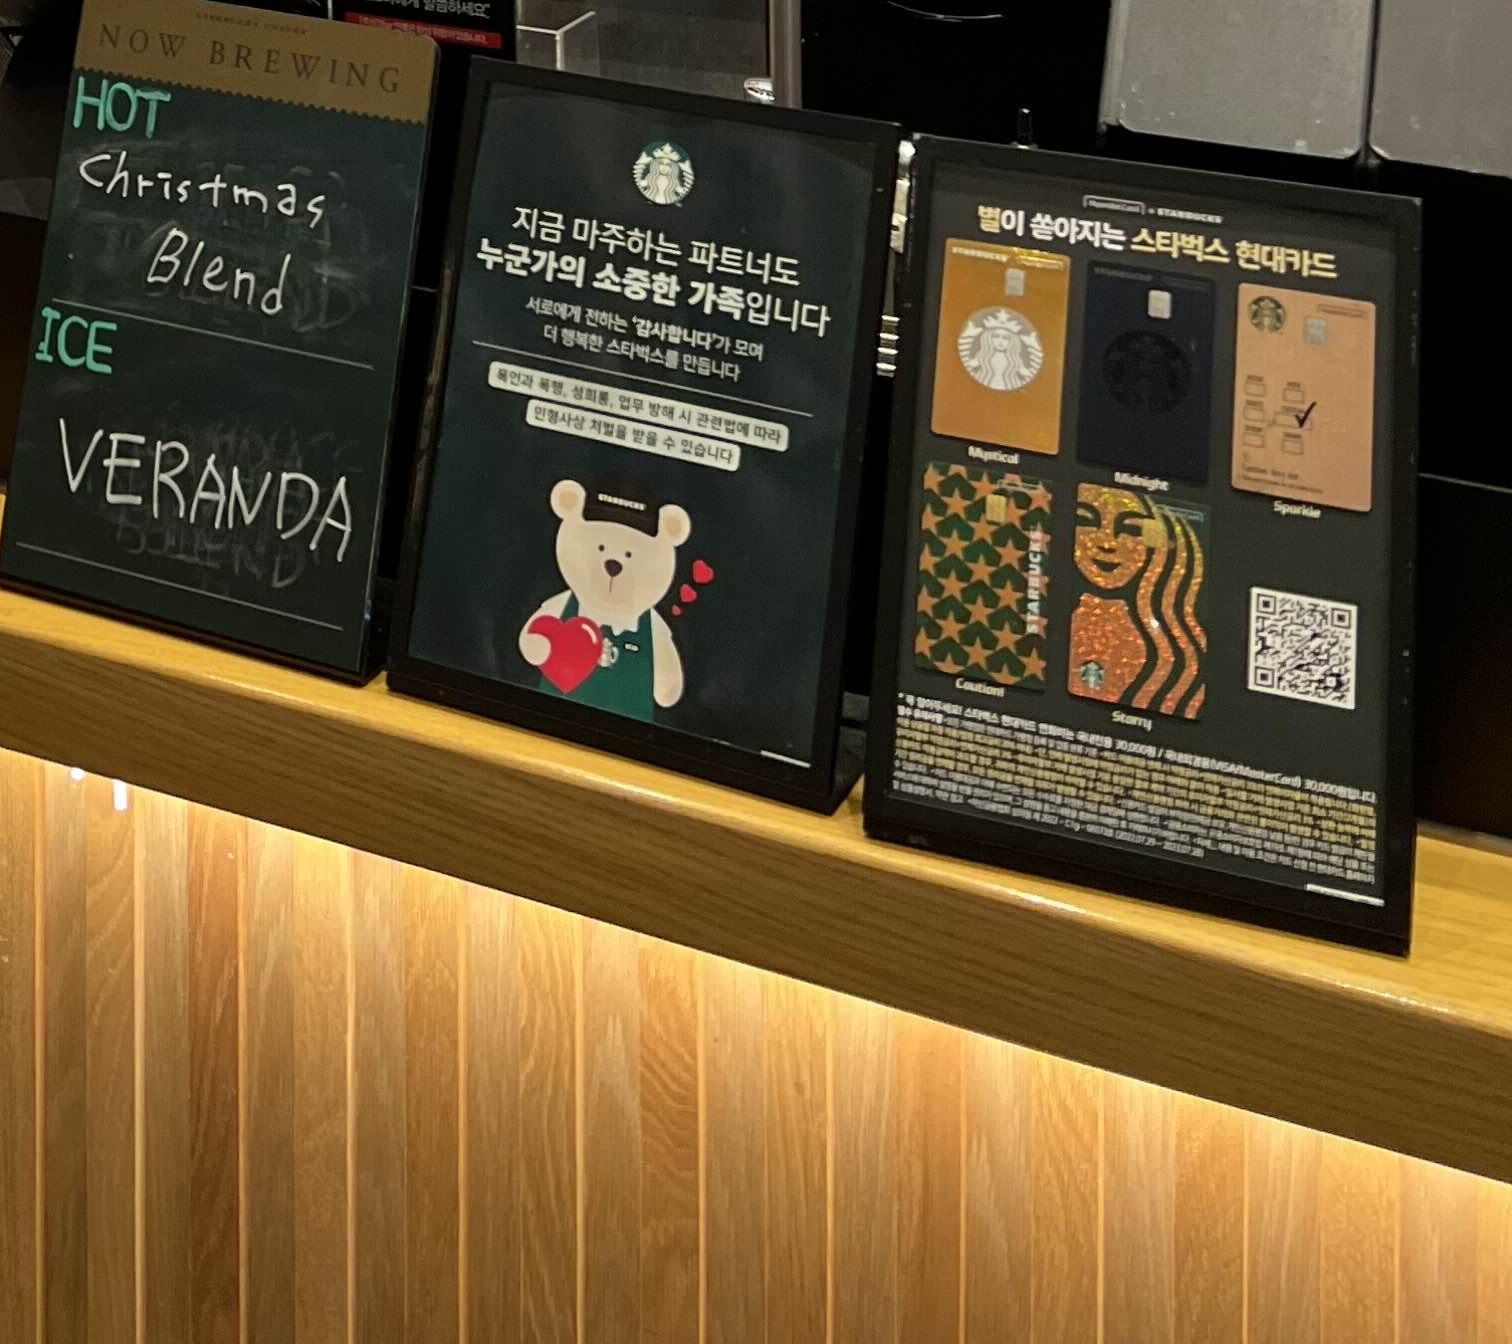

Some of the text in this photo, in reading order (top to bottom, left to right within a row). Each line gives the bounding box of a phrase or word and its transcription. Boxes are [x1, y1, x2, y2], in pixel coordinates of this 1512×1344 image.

[96, 21, 401, 95] NOW BREWING
[70, 75, 170, 139] HOT
[78, 150, 326, 228] Christmas
[1157, 207, 1224, 224] STARBUCKS
[146, 226, 292, 316] Blend
[512, 207, 800, 286] 지금 마주하는 파트너도
[977, 205, 1338, 279] 별이 쏟아지는 스타벅스 현대카드
[476, 238, 832, 338] 누군가의 소중한 가족입니다
[36, 306, 118, 374] ICE
[525, 296, 581, 323] 서로에게
[585, 307, 628, 333] 전하는
[734, 338, 763, 362] 모여
[543, 324, 740, 383] 더 행복한 스타벅스를 만듭니다
[496, 368, 534, 389] 폭언과
[618, 395, 644, 413] 업무
[648, 401, 675, 421] 방해
[678, 407, 692, 423] 시
[697, 412, 750, 438] 관련법에
[753, 425, 782, 444] 따라
[534, 404, 733, 464] 민형사상 처벌을 받을 수 있습니다
[968, 445, 1019, 465] Mystical
[1114, 471, 1169, 492] Midnight
[58, 416, 353, 563] VERANDA
[598, 493, 646, 511] STARBUCKS
[1274, 500, 1321, 519] Sparkle
[1112, 709, 1152, 732] Starry
